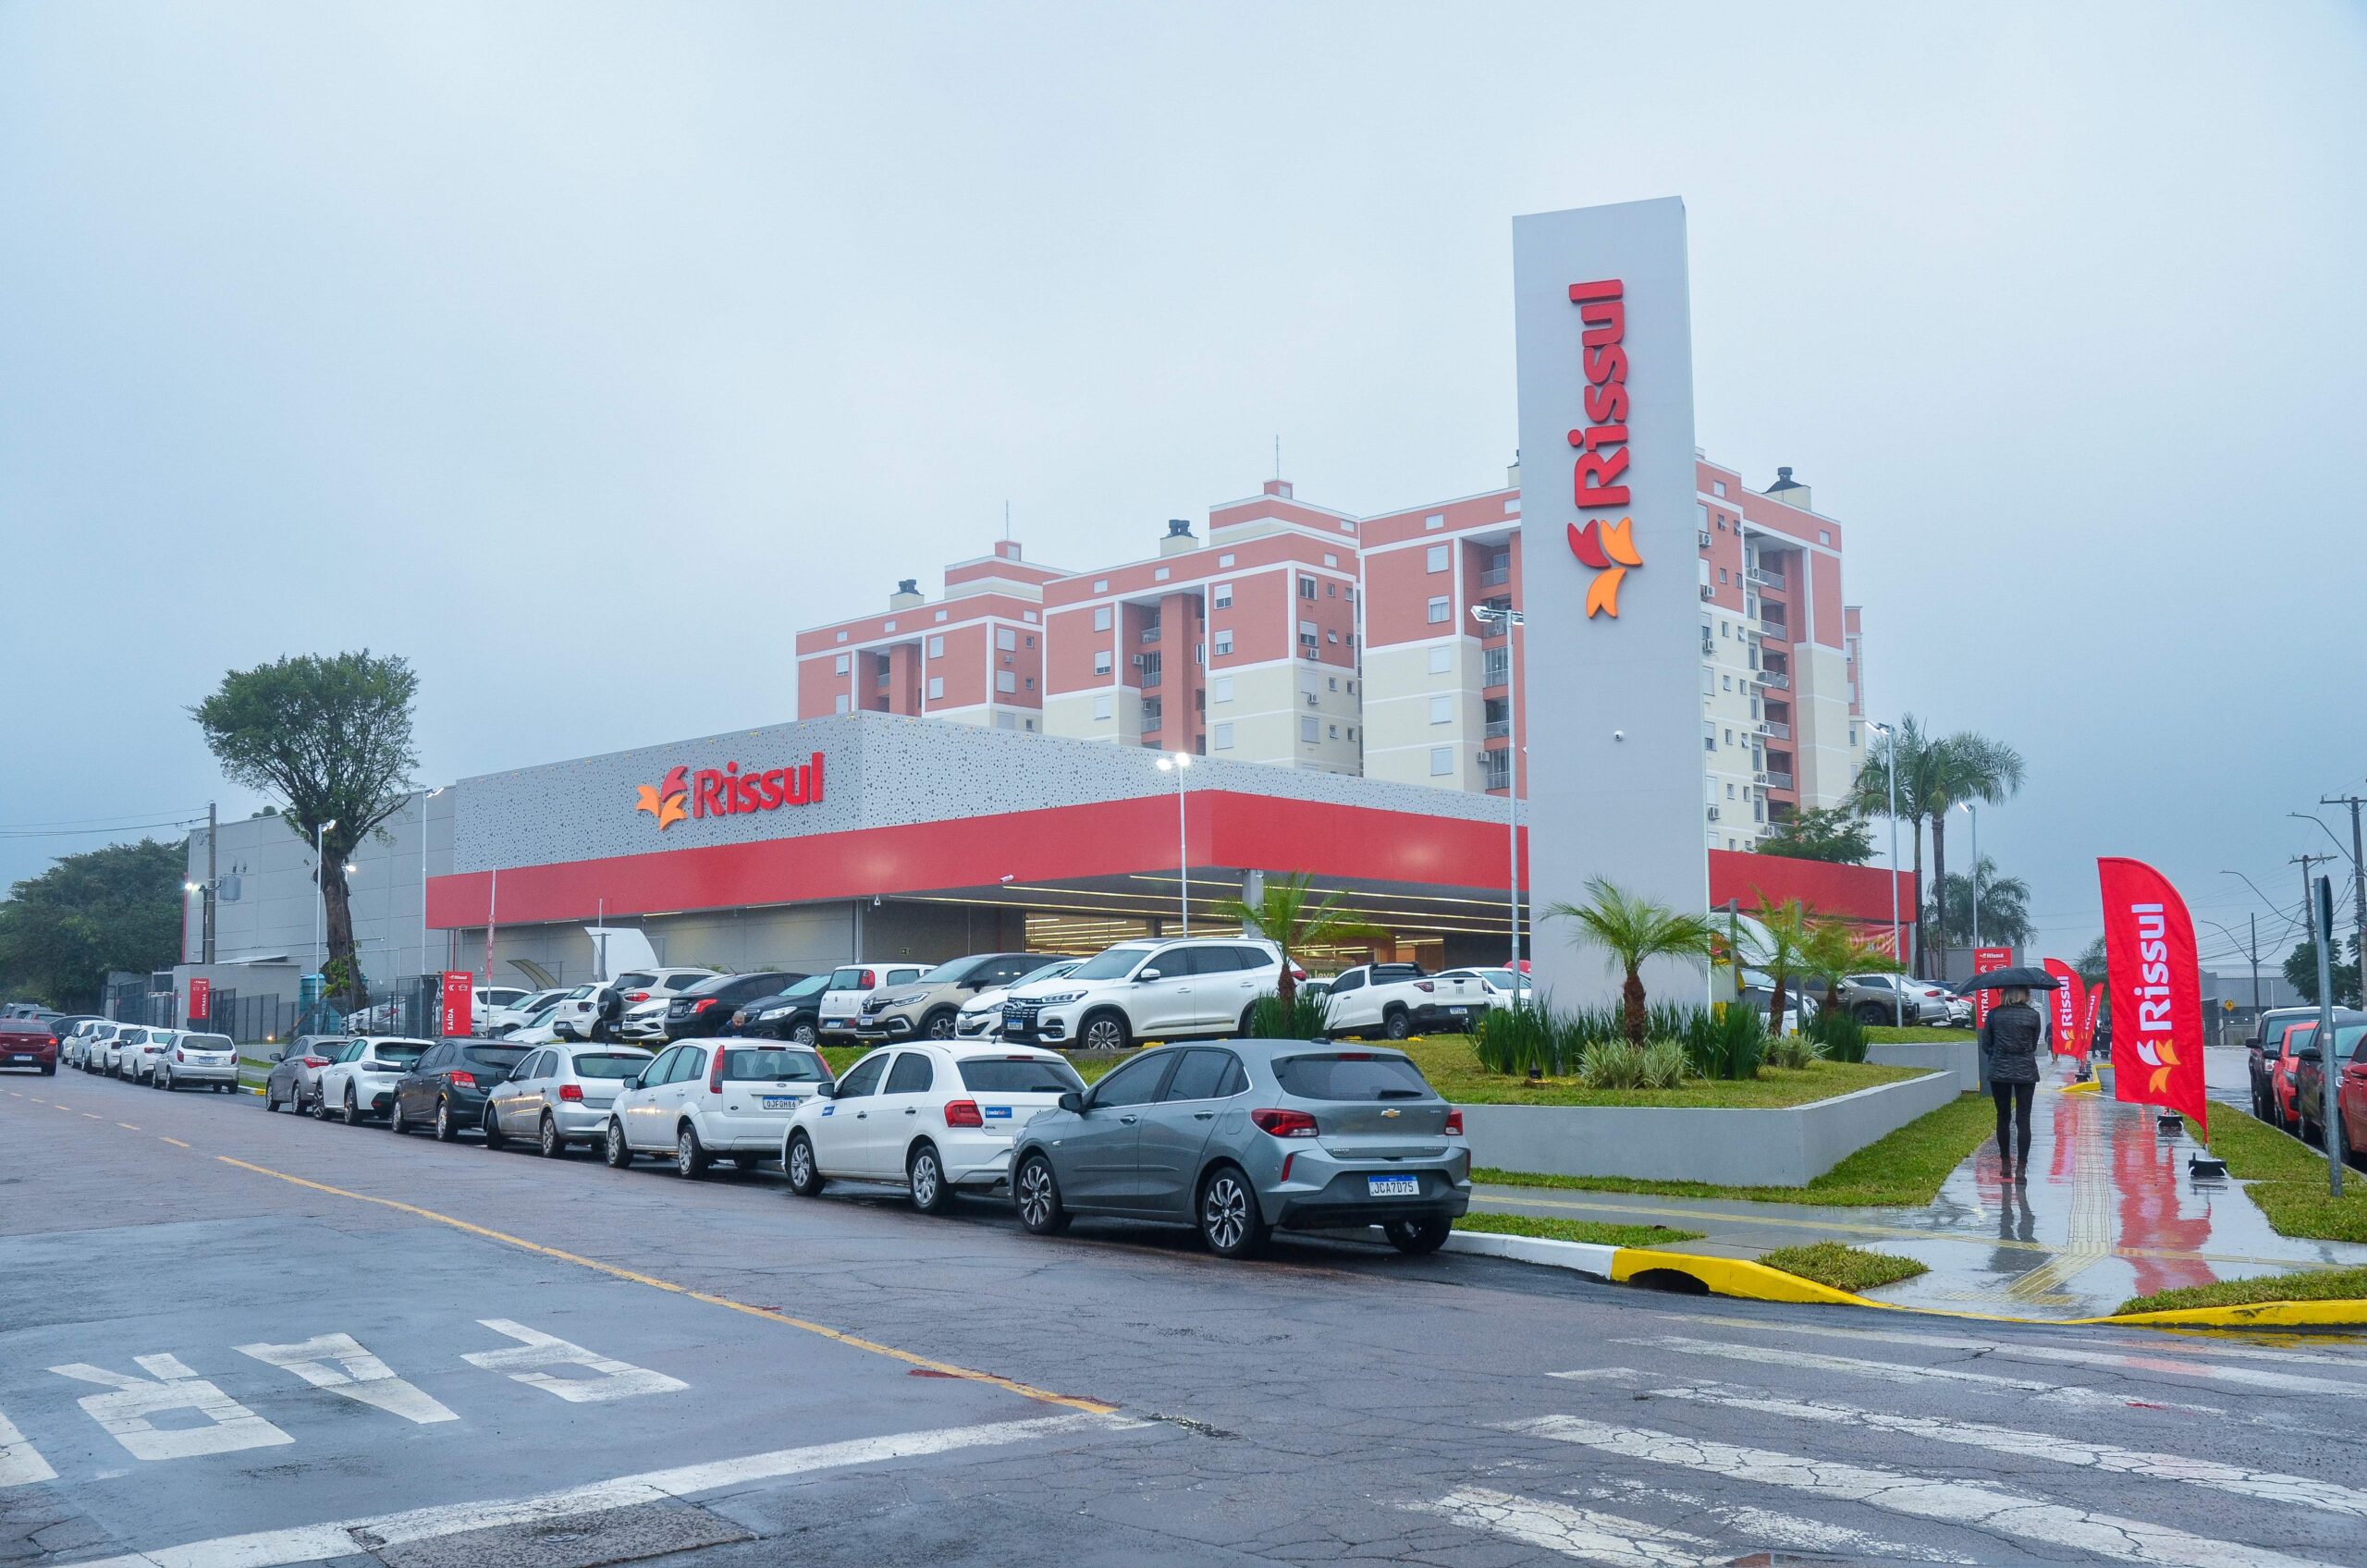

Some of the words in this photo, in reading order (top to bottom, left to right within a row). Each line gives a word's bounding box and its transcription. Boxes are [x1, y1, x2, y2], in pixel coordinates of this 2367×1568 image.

[1567, 278, 1630, 508] Rissul
[693, 751, 825, 818] Rissul
[2057, 975, 2073, 1027] Rissul
[2131, 903, 2173, 1032] Rissul
[1374, 1182, 1414, 1194] JCA7D75
[0, 1318, 691, 1488] PAR
